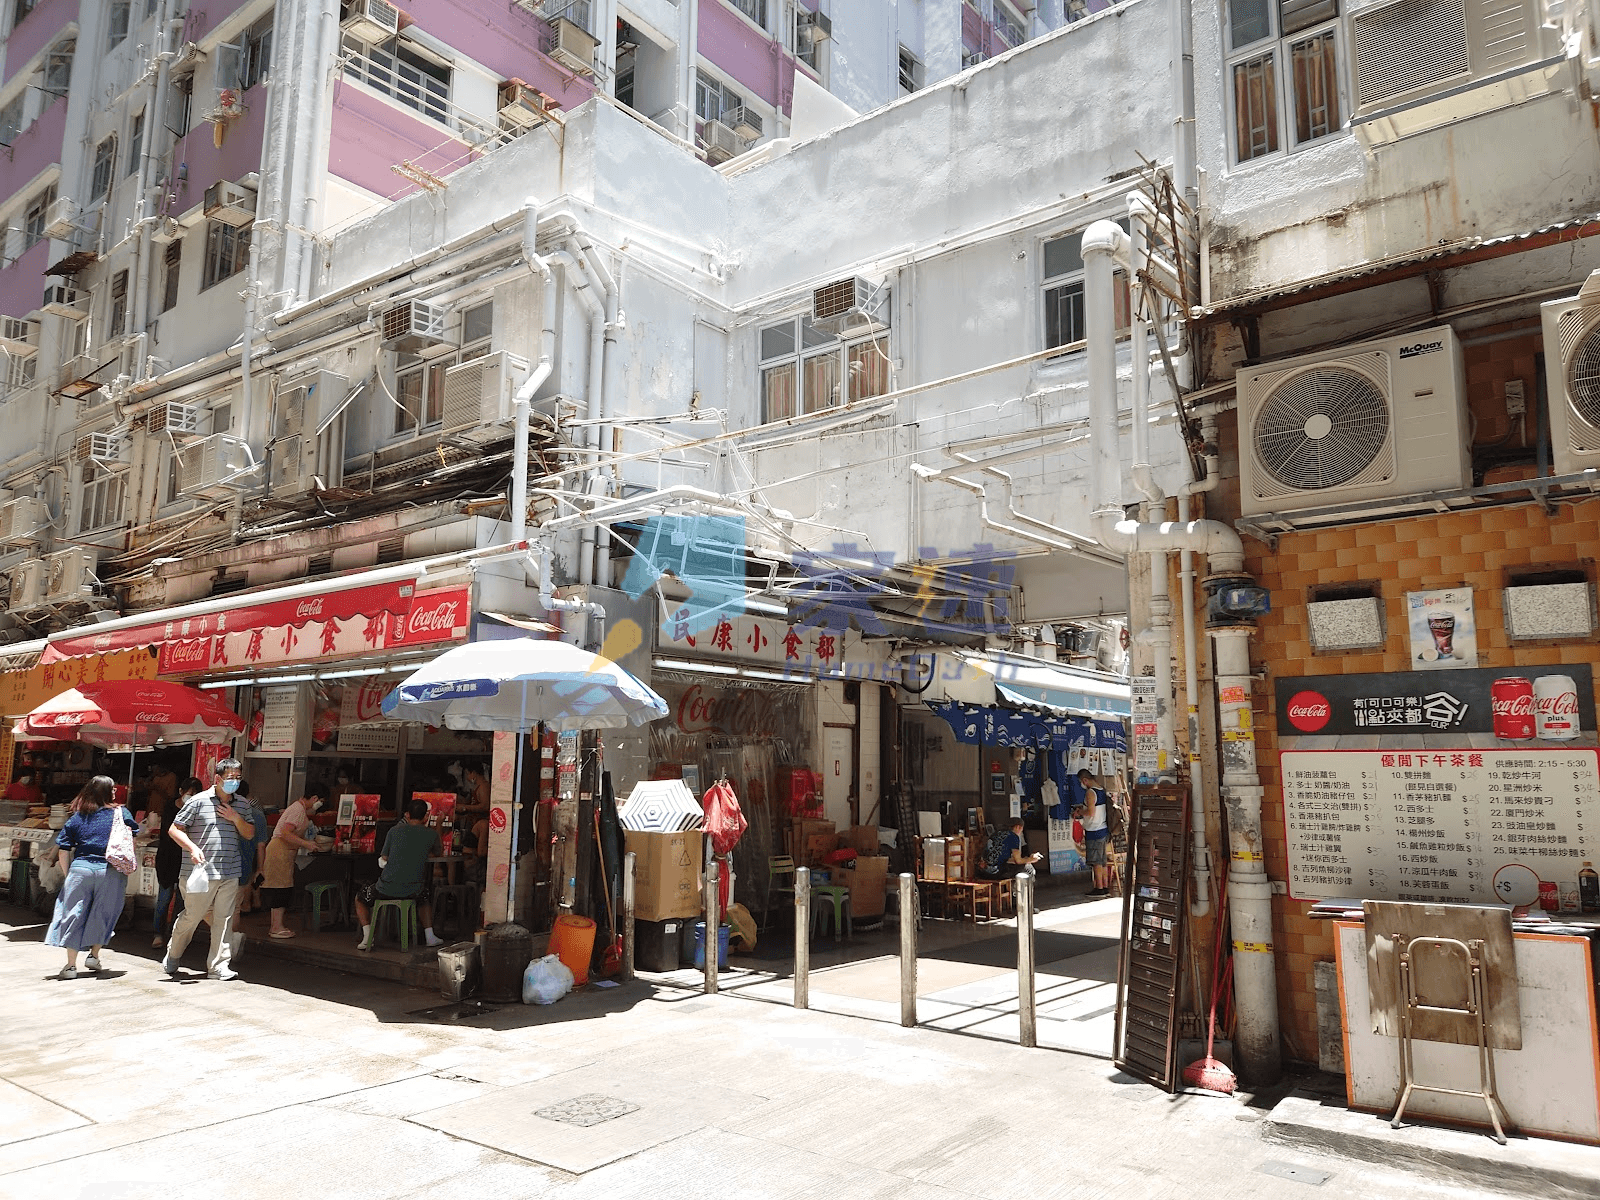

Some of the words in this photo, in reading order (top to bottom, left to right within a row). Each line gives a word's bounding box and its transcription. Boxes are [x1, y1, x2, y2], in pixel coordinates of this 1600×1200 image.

[1400, 340, 1443, 355] McQuay
[296, 598, 325, 618] Coca-Cola
[409, 601, 461, 634] Coca-Cola
[672, 608, 836, 666] 民康小食部
[135, 711, 171, 722] Coca-Cola
[1289, 704, 1327, 718] Coca-Cola
[1538, 760, 1558, 768] 2:15
[1567, 759, 1587, 768] 5:30
